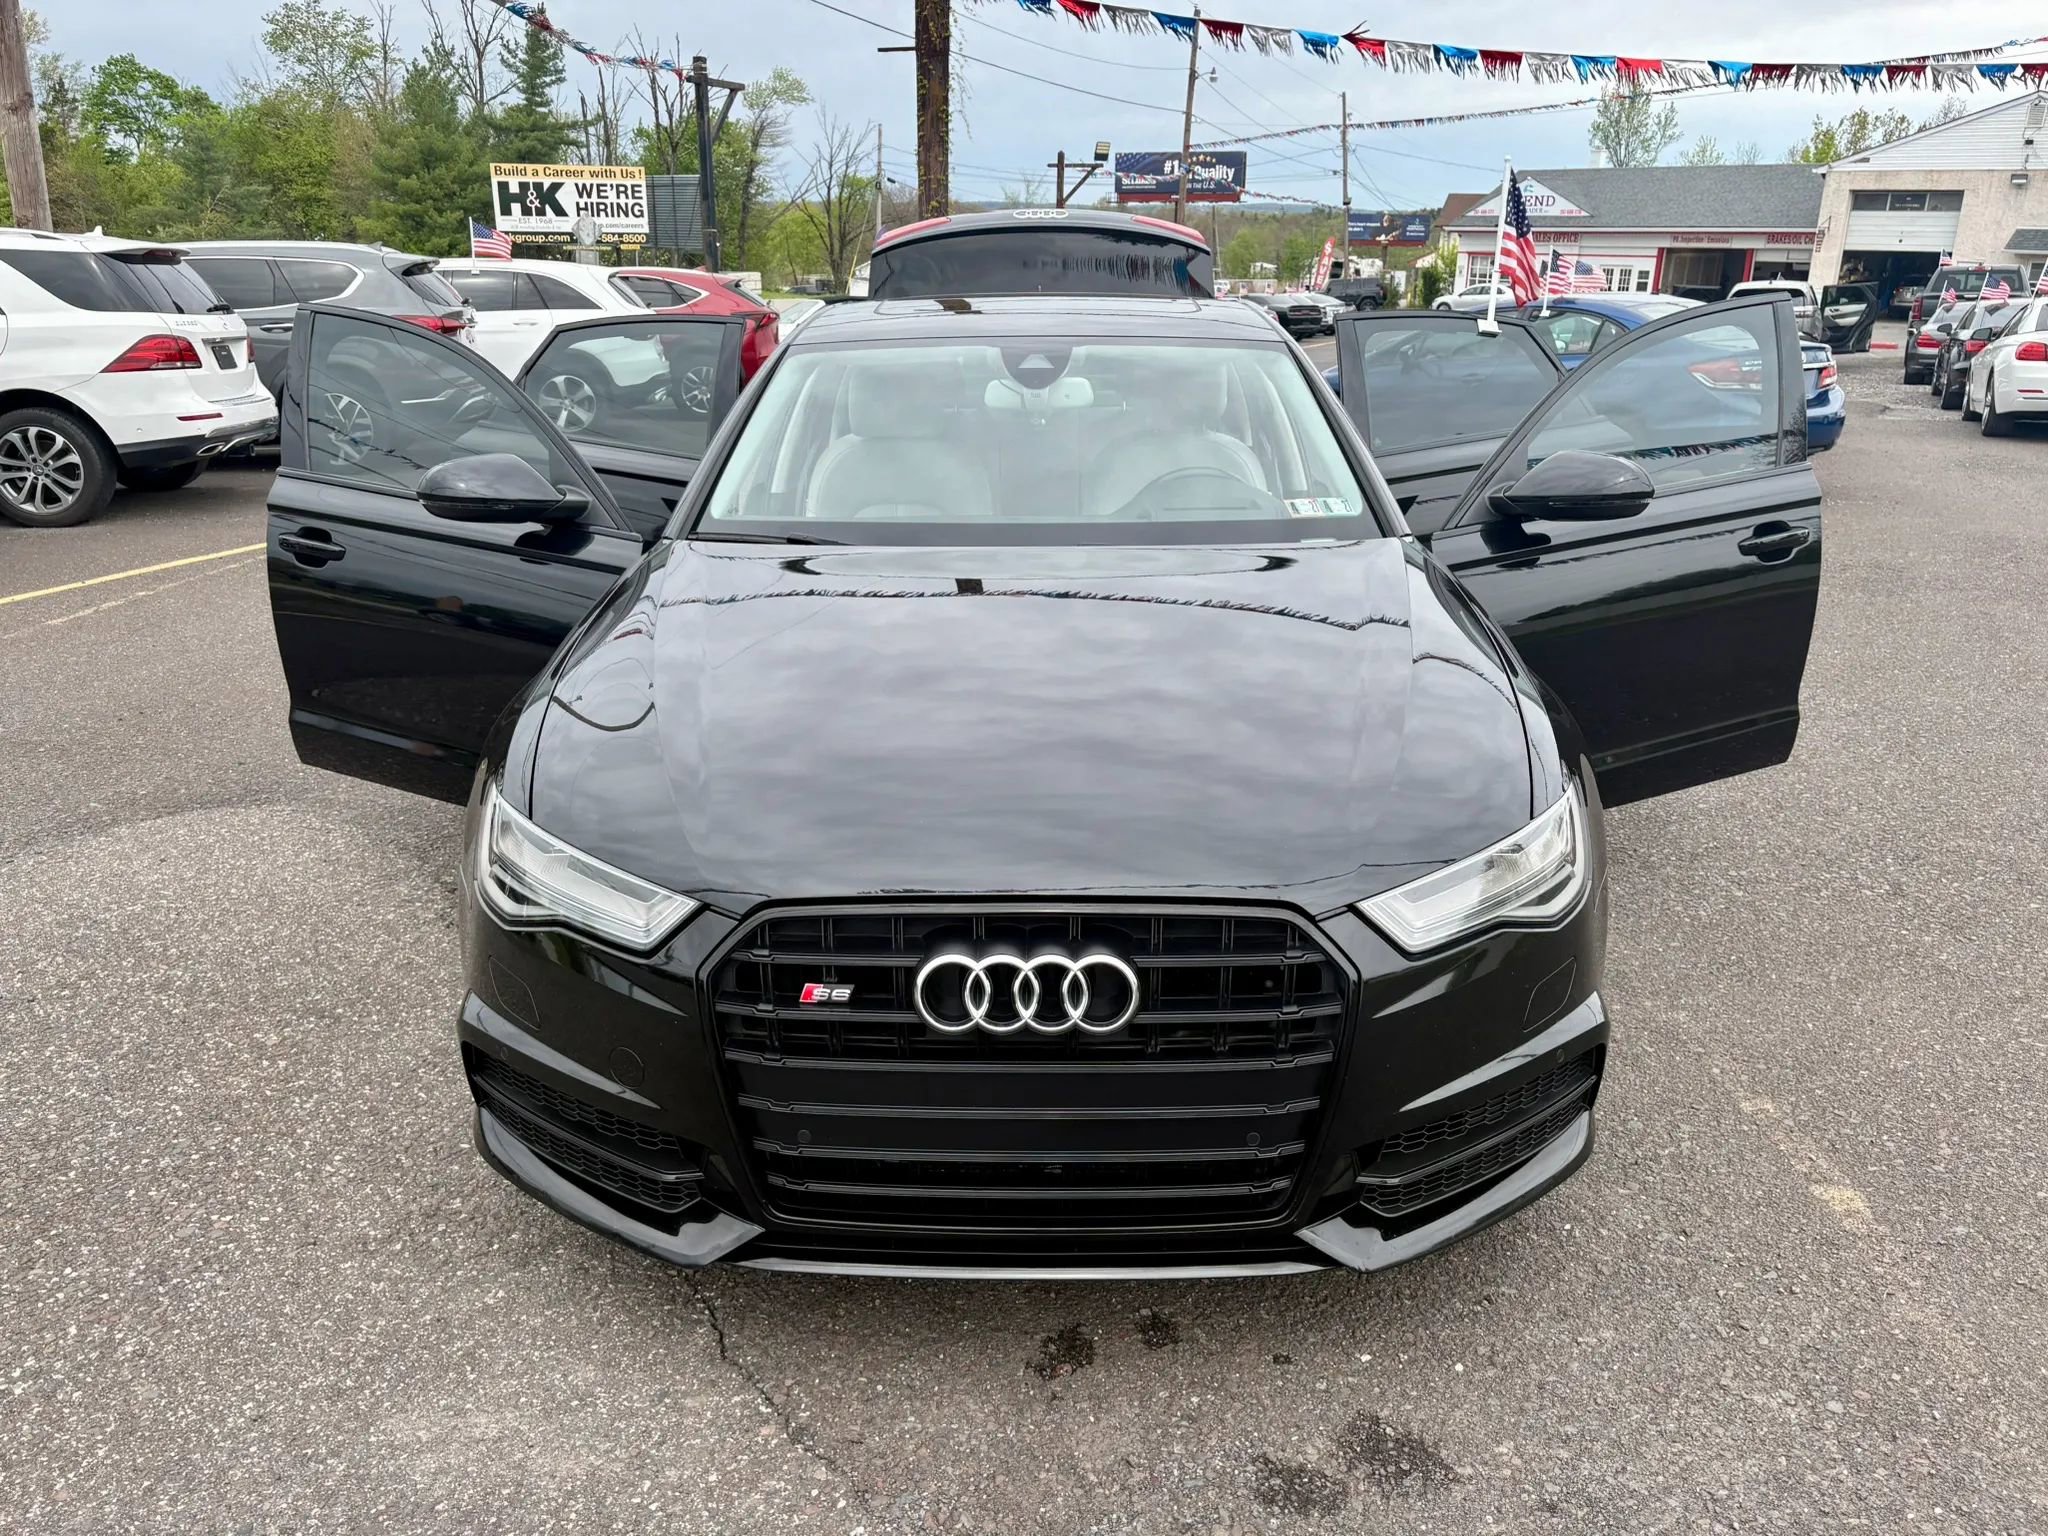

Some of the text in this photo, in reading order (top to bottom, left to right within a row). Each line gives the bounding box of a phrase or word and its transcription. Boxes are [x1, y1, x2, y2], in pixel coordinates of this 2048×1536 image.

[494, 165, 527, 177] Build
[532, 168, 539, 177] a
[543, 166, 585, 178] Career
[589, 168, 617, 179] with
[1194, 164, 1235, 182] Quality
[497, 181, 570, 218] H&K
[1523, 195, 1556, 207] END
[575, 201, 645, 218] HIRING
[508, 232, 571, 243] kgroup.com
[597, 233, 647, 243] -584-8500
[1532, 231, 1579, 243] ALES OFFICE
[1316, 242, 1333, 284] SAVE
[812, 988, 851, 1001] S6
